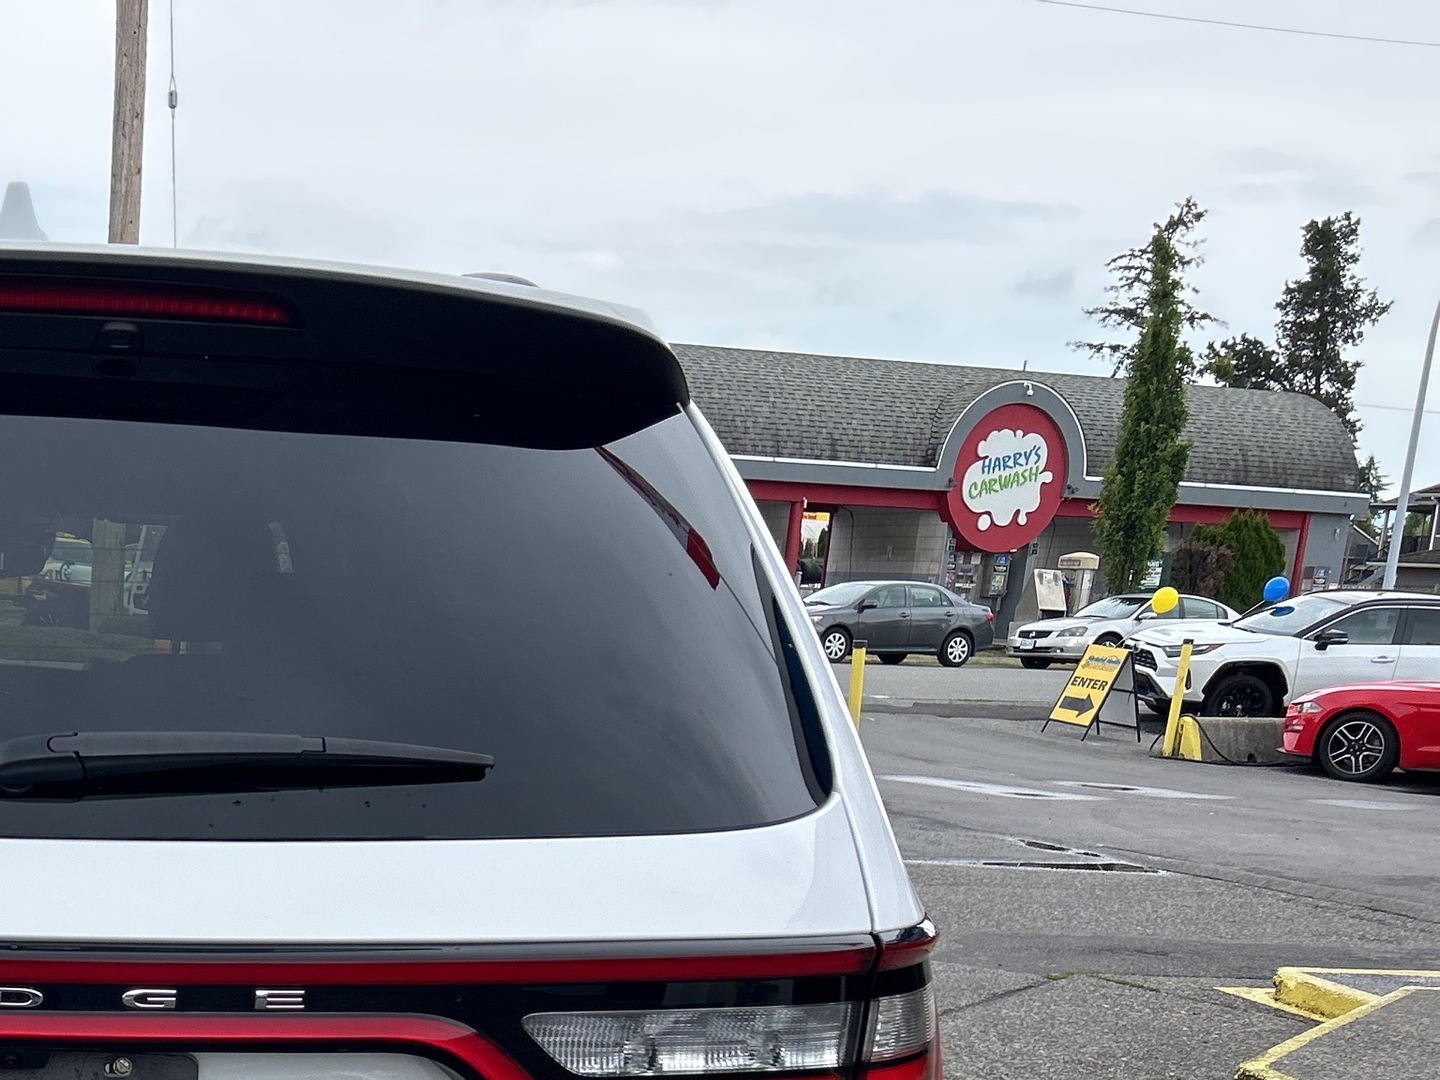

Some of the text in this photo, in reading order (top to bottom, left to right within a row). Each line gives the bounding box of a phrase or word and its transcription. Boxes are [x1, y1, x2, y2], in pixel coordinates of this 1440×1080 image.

[981, 445, 1041, 475] HARRY'S
[968, 466, 1040, 500] CARWASH
[1070, 676, 1108, 692] ENTER
